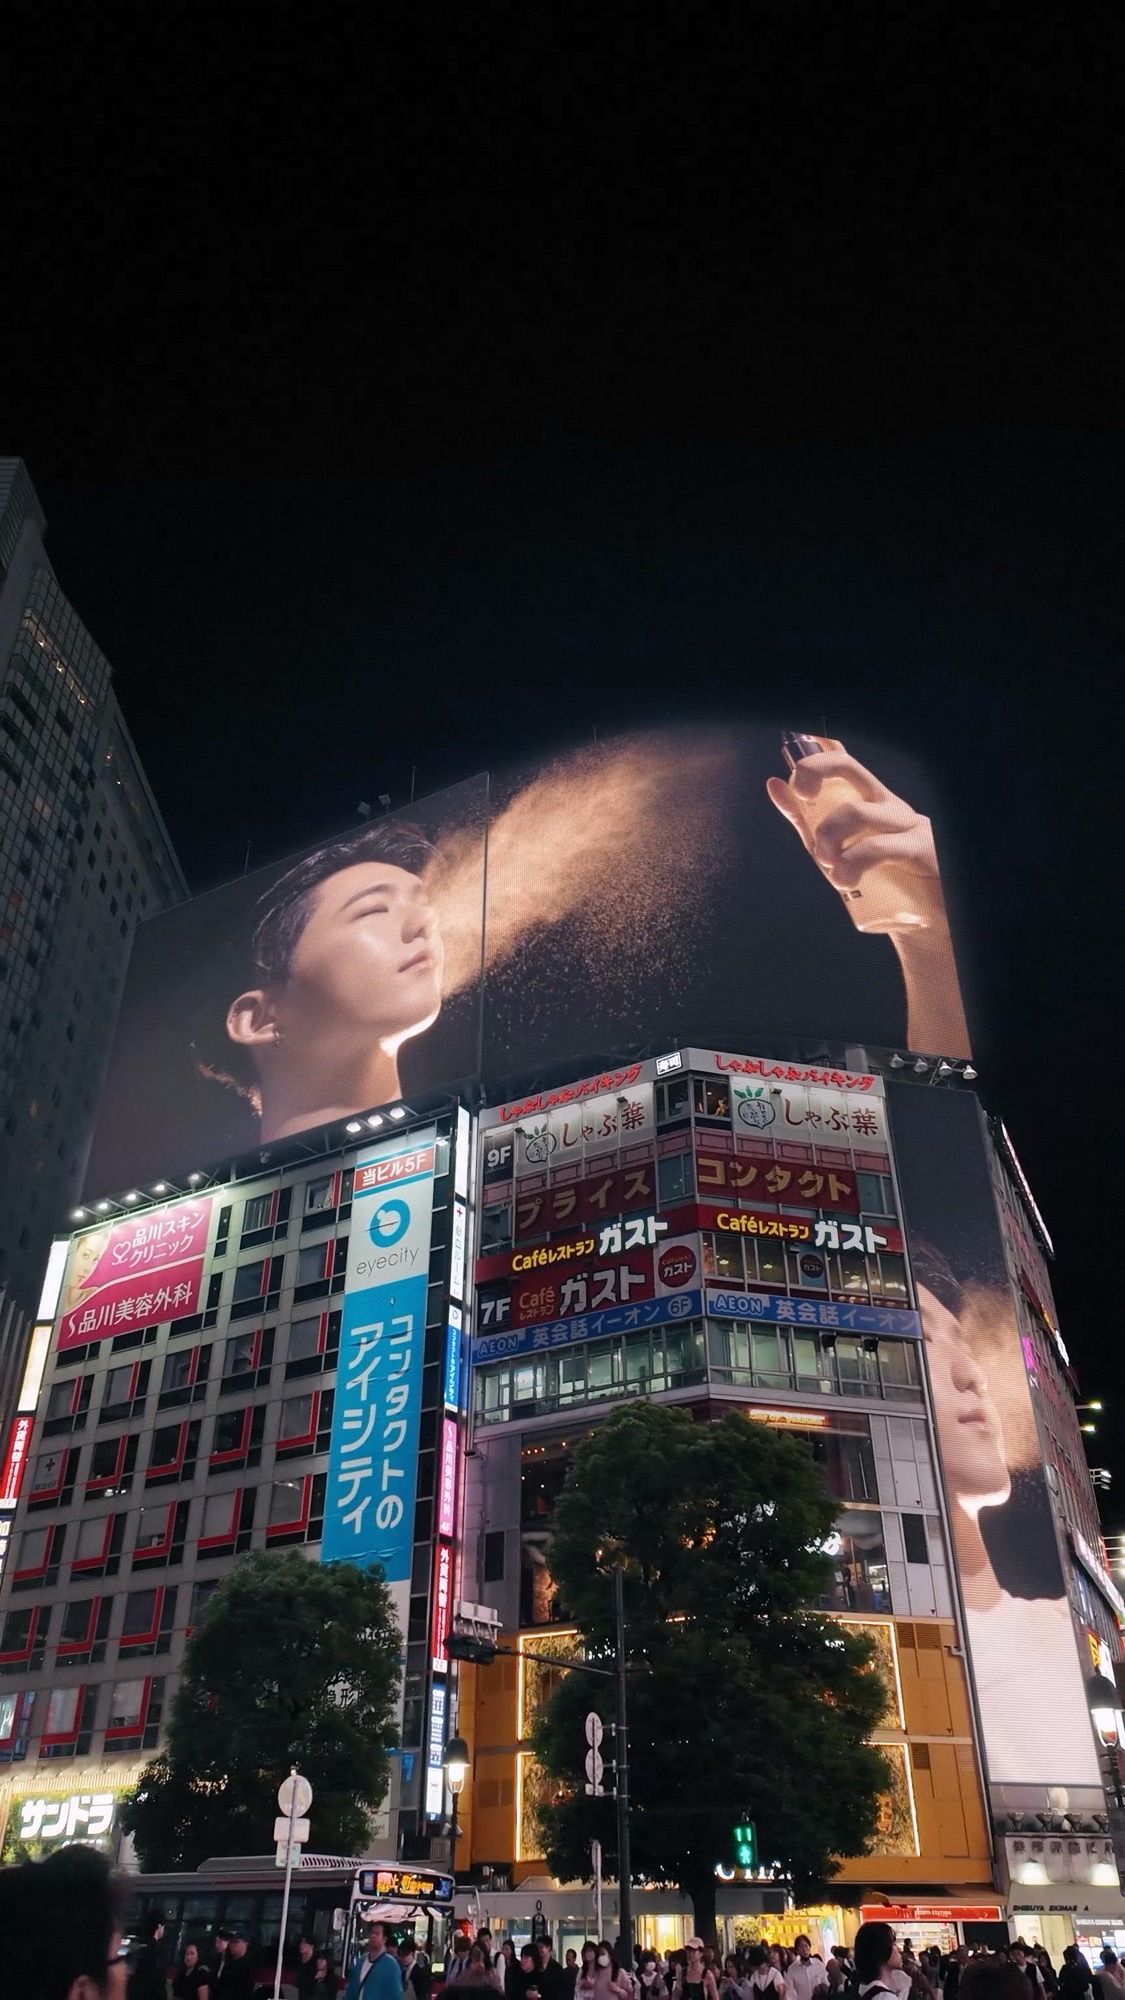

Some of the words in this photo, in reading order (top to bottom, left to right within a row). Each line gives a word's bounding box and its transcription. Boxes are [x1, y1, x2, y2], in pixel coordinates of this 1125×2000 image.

[716, 1054, 875, 1091] しゃぶしゃぶバイキング
[500, 1064, 642, 1121] しゃぶしゃぶバイキング
[562, 1101, 645, 1147] しゃぶ葉
[784, 1098, 879, 1136] しゃぶ葉
[362, 1153, 427, 1188] 当ビル5F
[487, 1145, 511, 1168] 9F
[698, 1158, 851, 1201] コンタクト
[518, 1170, 651, 1229] プライス
[133, 1212, 205, 1246] 品川スキン
[599, 1215, 668, 1256] ガスト
[814, 1220, 887, 1253] ガスト
[129, 1235, 194, 1268] クリニック
[357, 1247, 419, 1277] eyecity
[663, 1263, 693, 1278] ガスト
[78, 1281, 193, 1334] 品川美容外科
[519, 1285, 555, 1309] Café
[560, 1265, 645, 1316] ガスト
[479, 1335, 519, 1357] AEON
[532, 1306, 660, 1349] 英会話イーオン
[671, 1298, 690, 1315] 6F
[481, 1297, 511, 1325] 7F
[519, 1304, 555, 1321] レストラン
[714, 1296, 764, 1314] AEON
[776, 1300, 919, 1331] 英会話イーオン
[338, 1321, 384, 1534] アイシティ
[375, 1314, 414, 1529] コンタクトの
